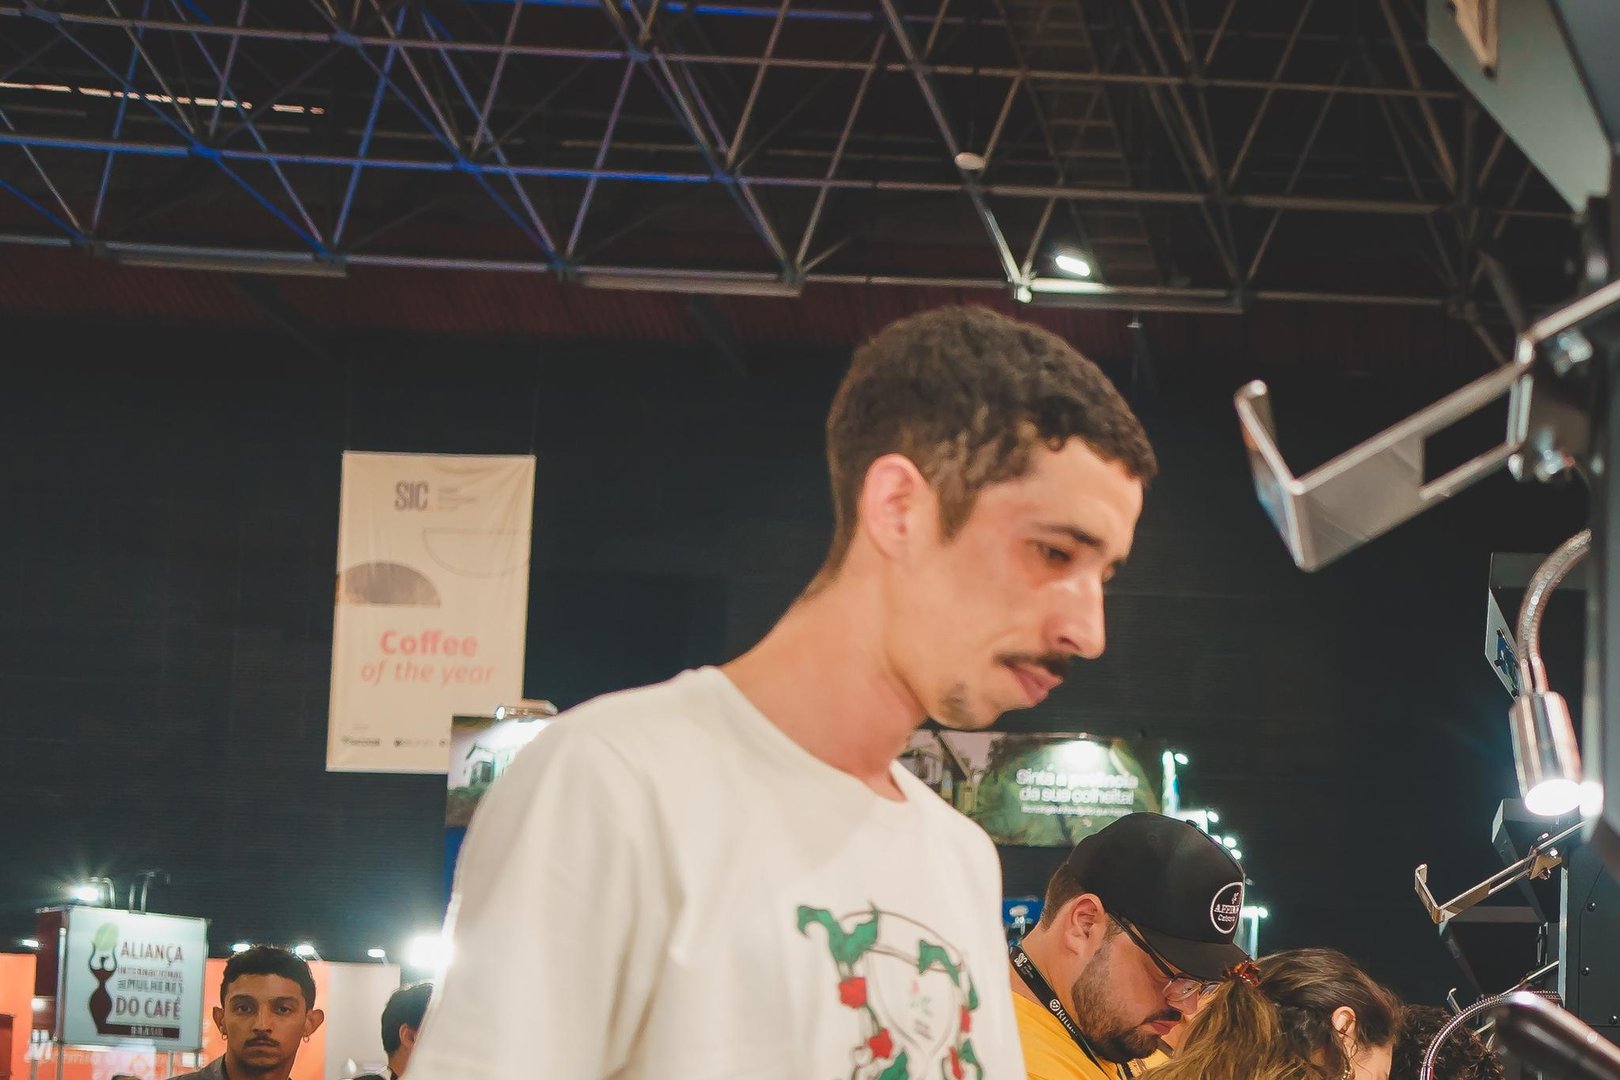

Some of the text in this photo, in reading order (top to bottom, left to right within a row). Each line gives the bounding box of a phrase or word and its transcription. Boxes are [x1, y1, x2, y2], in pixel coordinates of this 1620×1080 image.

[394, 479, 429, 512] SIC
[379, 629, 479, 657] Coffee
[360, 660, 496, 688] of the year
[120, 941, 183, 967] ALIANÇA
[115, 996, 182, 1020] DO CAFÉ
